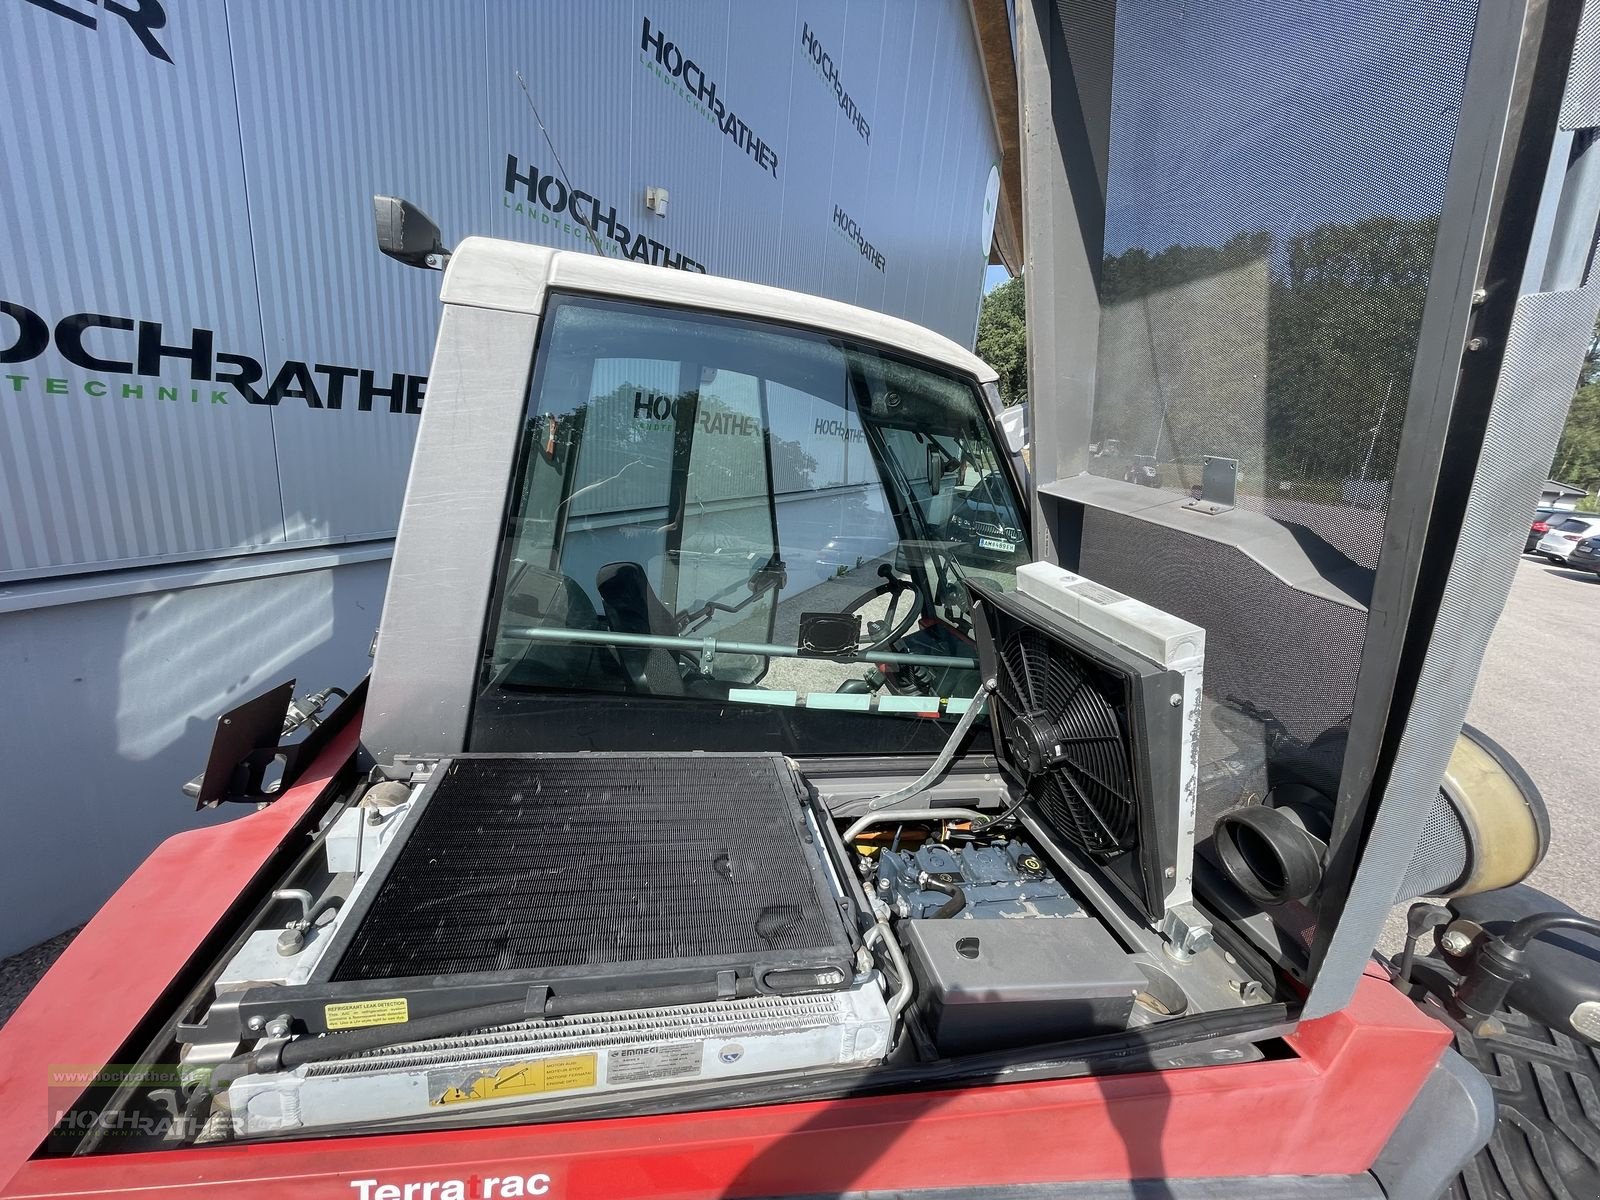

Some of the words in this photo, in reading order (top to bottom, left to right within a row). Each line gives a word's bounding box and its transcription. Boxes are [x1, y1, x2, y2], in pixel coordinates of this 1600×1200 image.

[639, 53, 716, 126] LANDTECHNIK
[641, 16, 778, 180] HOCHRATHER
[801, 21, 871, 146] HOCHRATHER
[833, 204, 886, 274] HOCHRATHER
[5, 374, 229, 405] TECHNIK
[621, 1046, 659, 1057] EMMEGI
[350, 1173, 551, 1200] Terratrac
